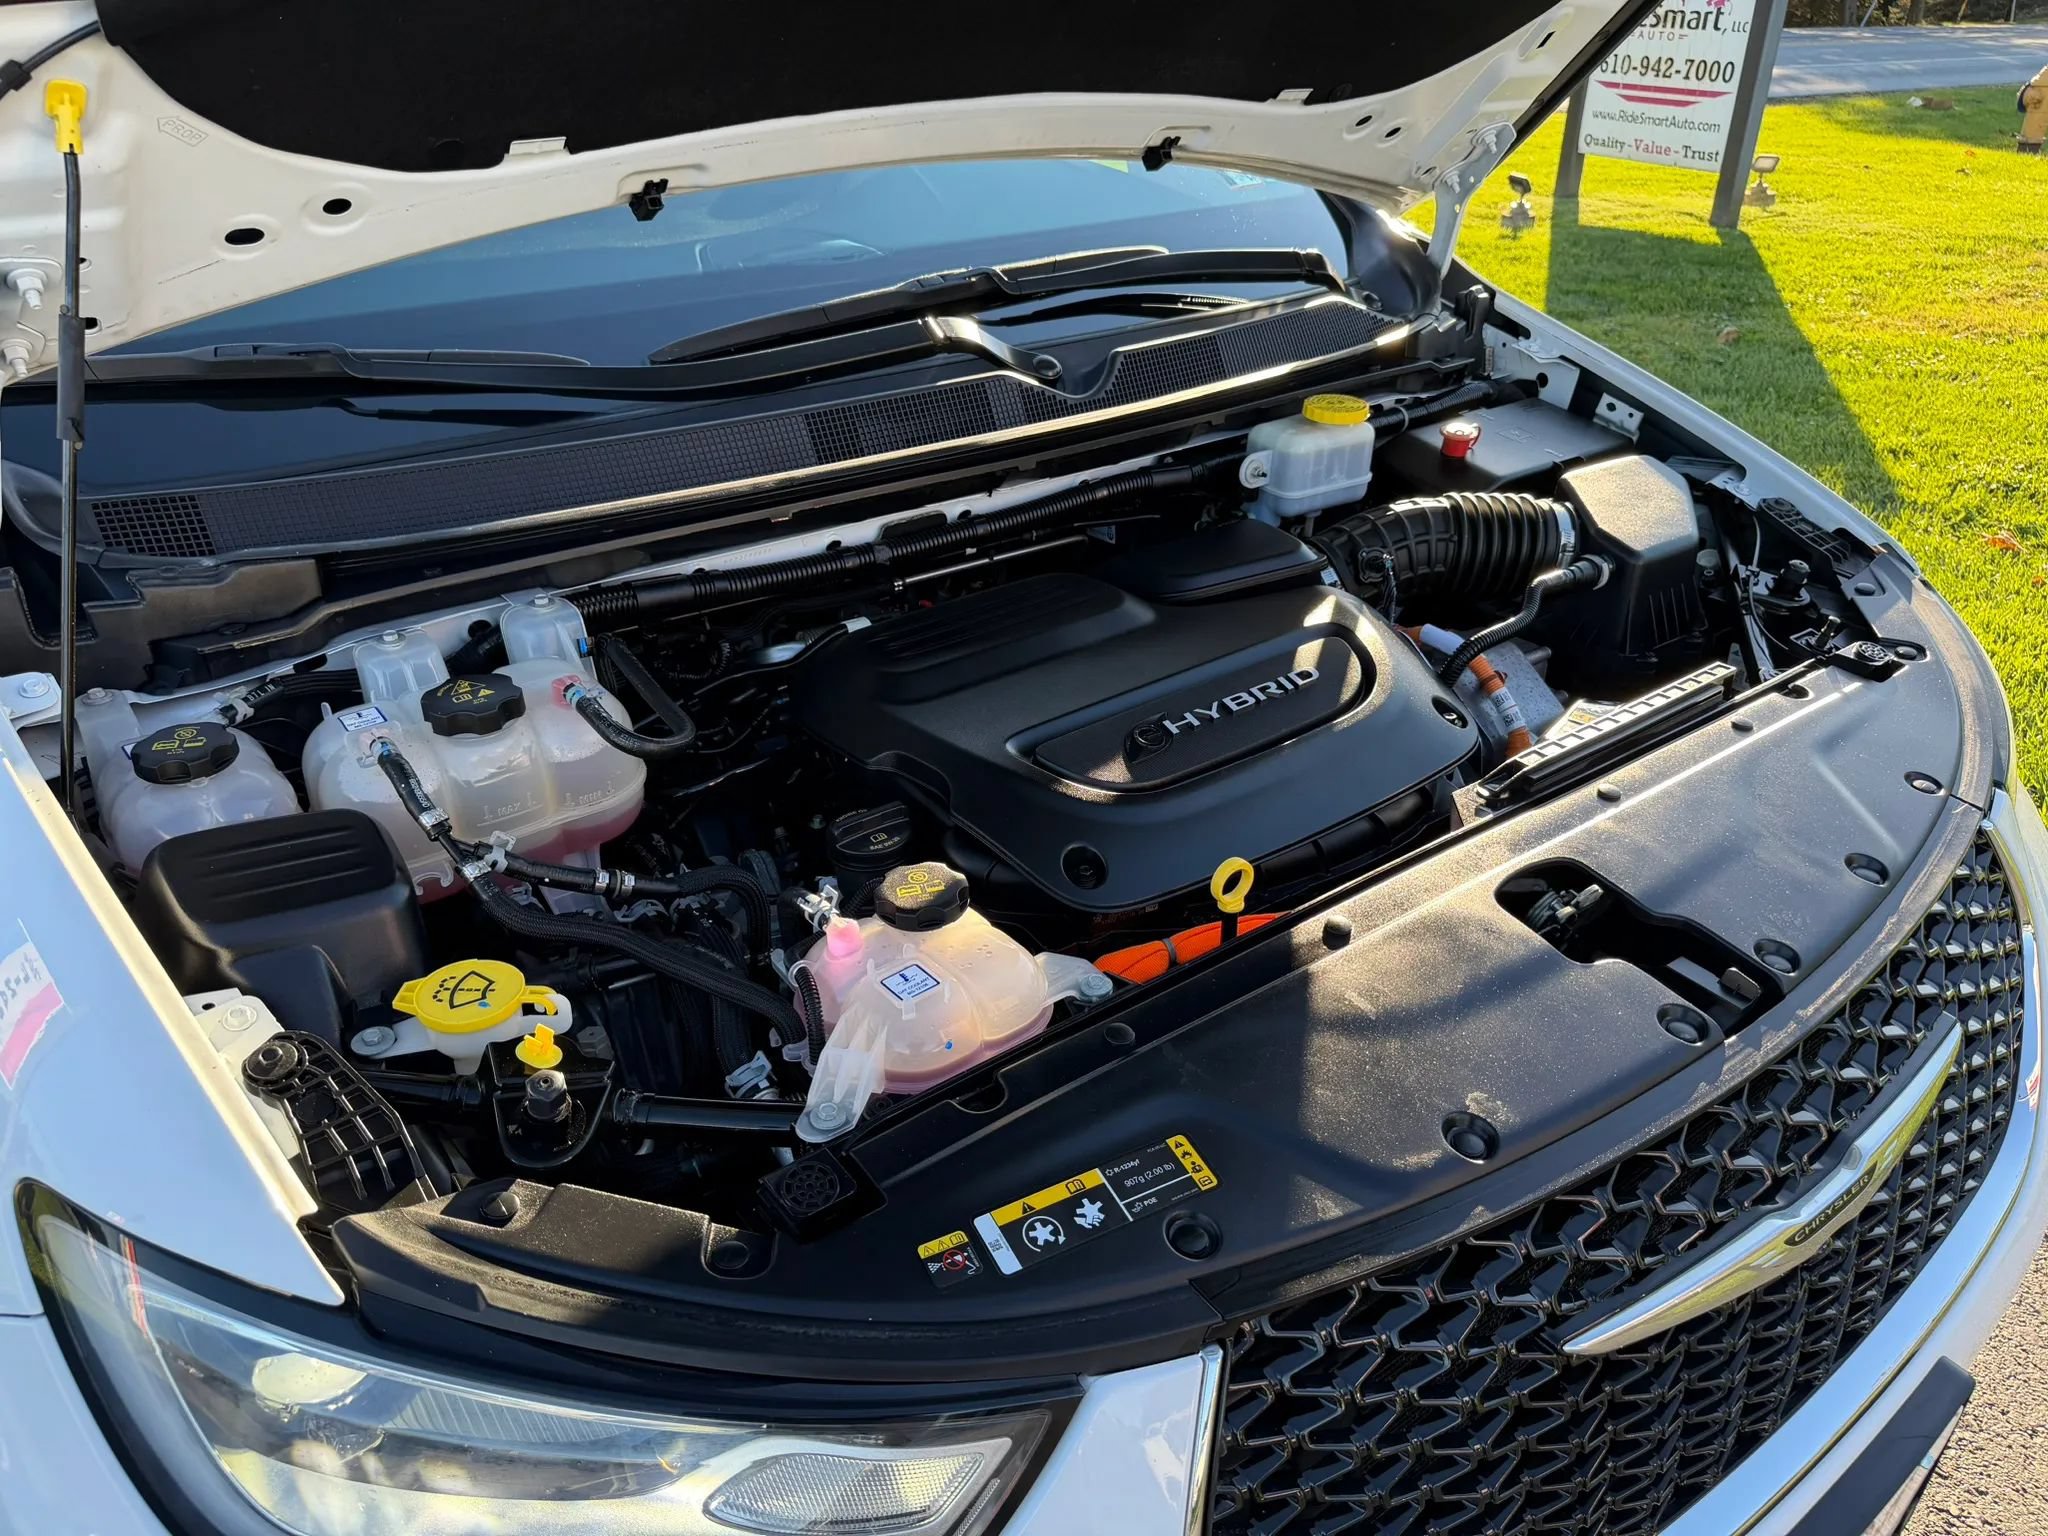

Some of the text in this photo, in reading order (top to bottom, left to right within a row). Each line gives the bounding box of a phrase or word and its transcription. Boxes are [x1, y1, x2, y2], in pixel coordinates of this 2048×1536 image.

[1731, 21, 1749, 33] LLC
[1600, 53, 1735, 83] 610-942-7000
[1592, 109, 1720, 133] www.RideSmartAuto.com
[1162, 666, 1320, 735] HYBRID
[1113, 1158, 1140, 1173] R-1234yf
[1124, 1174, 1145, 1187] 907g
[1144, 1167, 1164, 1180] (2.00
[1143, 1196, 1158, 1207] POE
[1794, 1175, 1869, 1242] CHRYSLER
